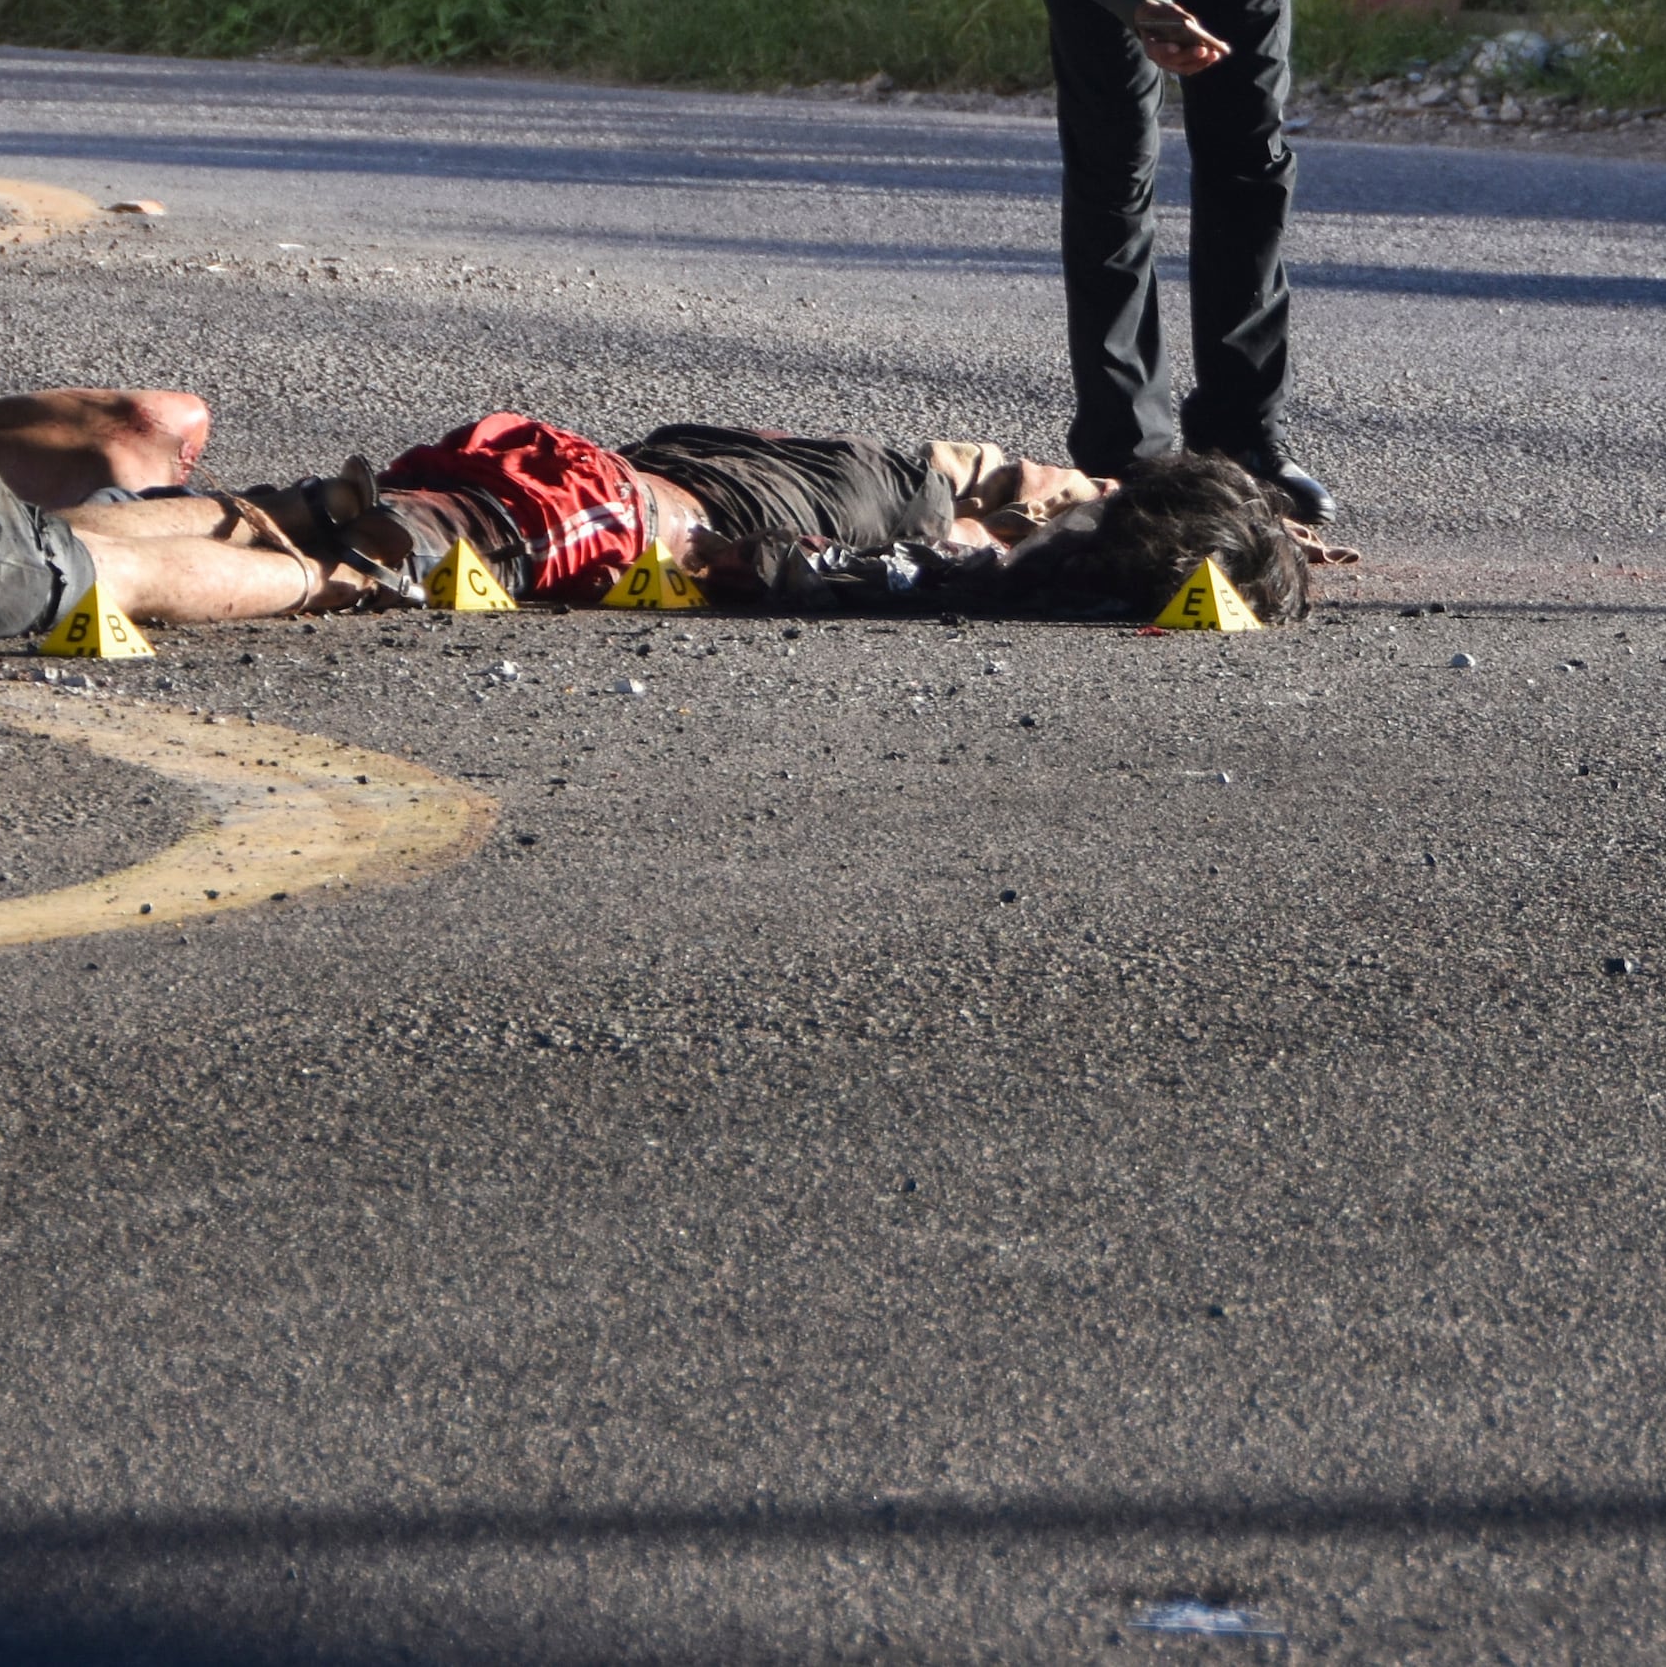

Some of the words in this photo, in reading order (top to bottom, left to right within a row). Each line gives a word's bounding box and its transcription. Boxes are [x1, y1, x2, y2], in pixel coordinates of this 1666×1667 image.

[431, 567, 452, 596] C
[468, 568, 487, 596] C
[627, 568, 650, 595] D
[665, 568, 687, 596] D
[1182, 588, 1206, 615] E
[1219, 589, 1239, 615] E
[66, 613, 90, 642] B
[107, 614, 127, 642] B
